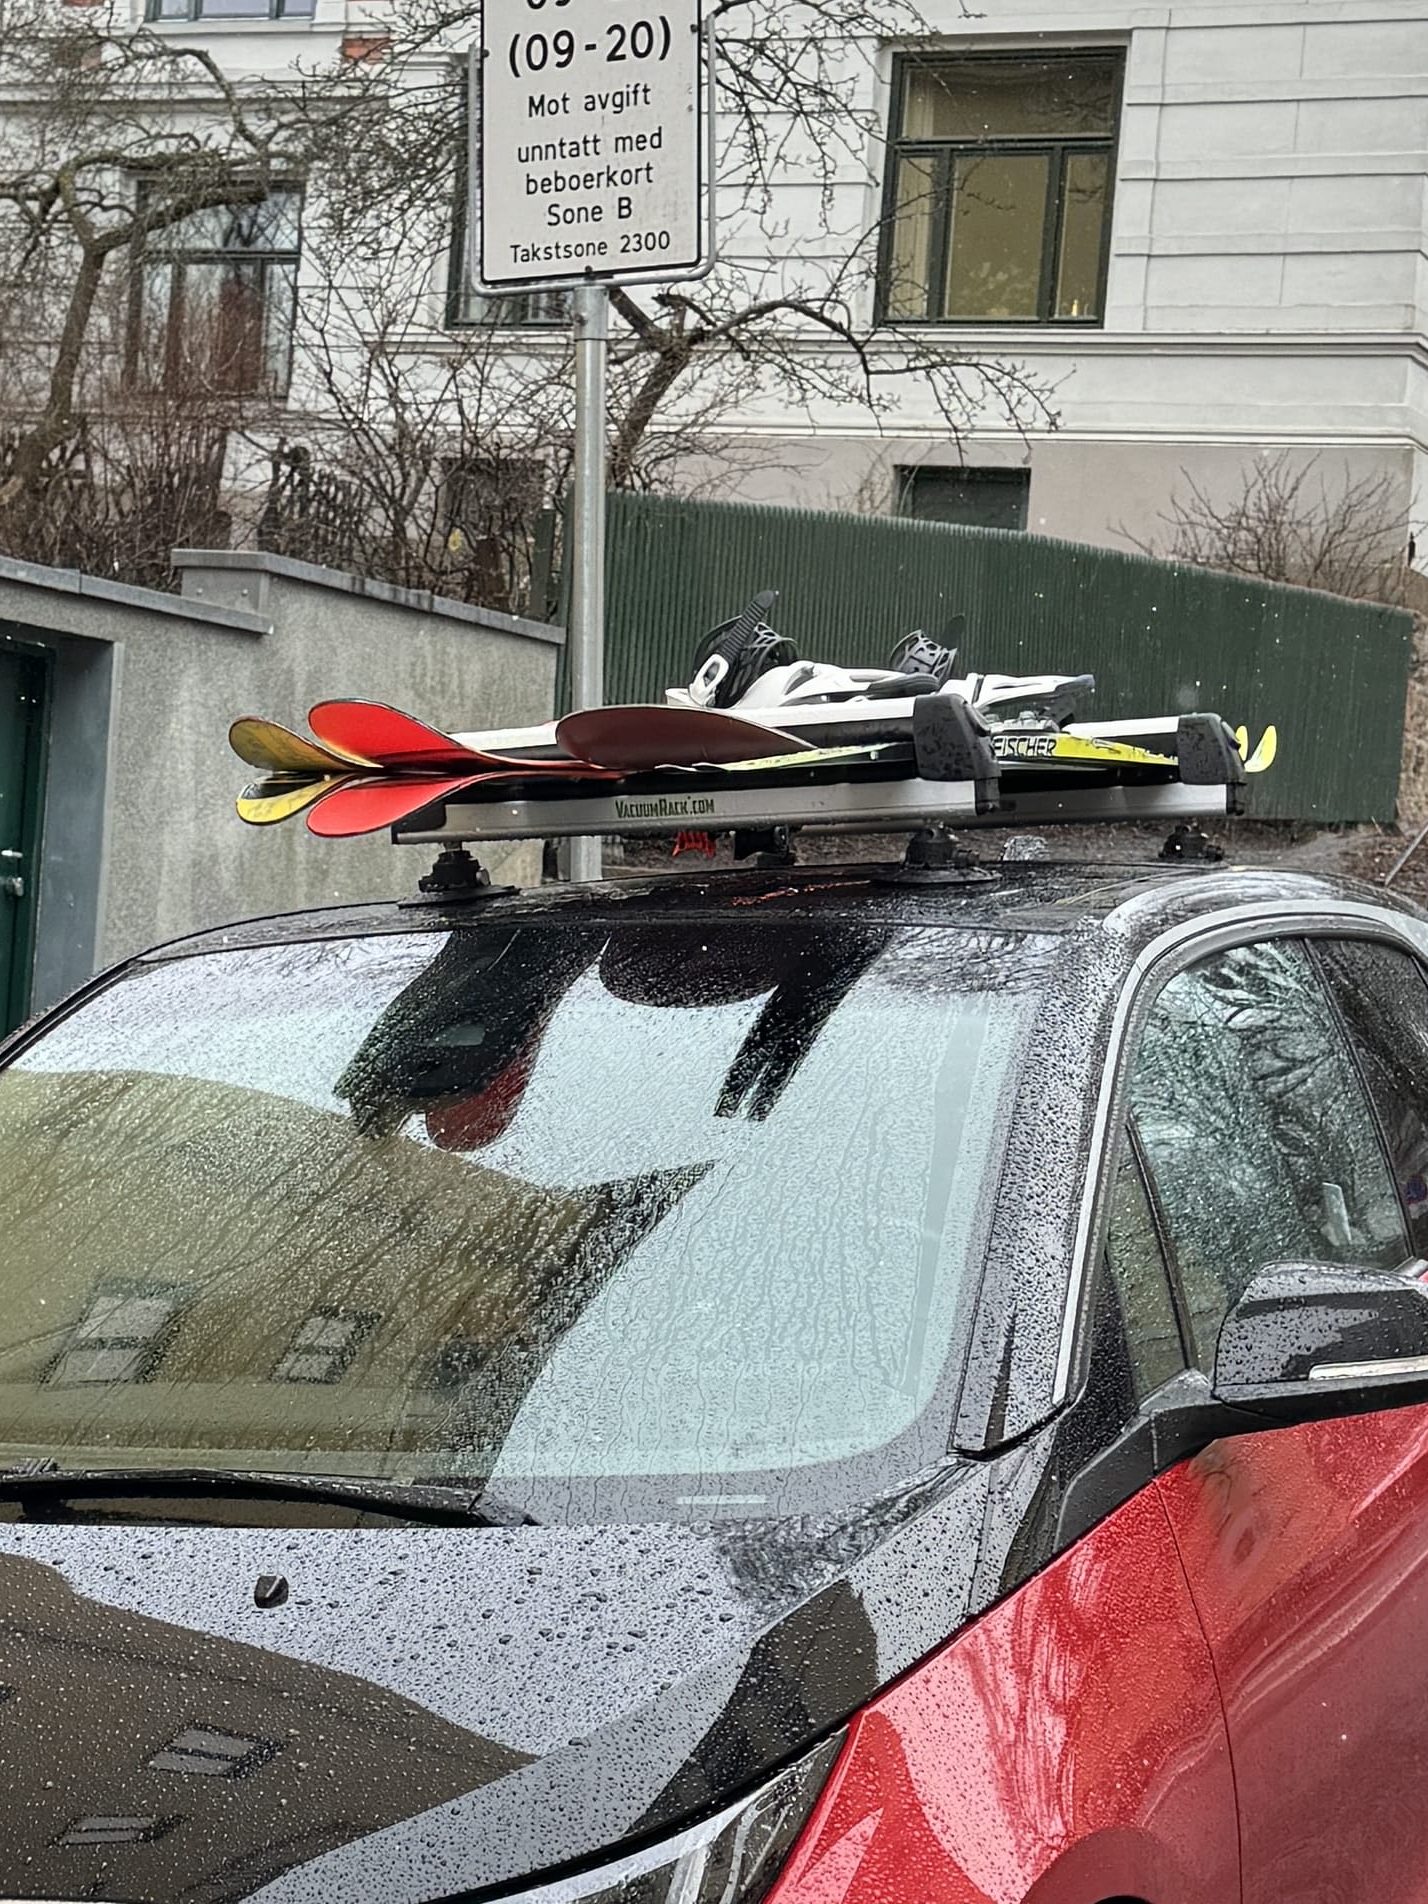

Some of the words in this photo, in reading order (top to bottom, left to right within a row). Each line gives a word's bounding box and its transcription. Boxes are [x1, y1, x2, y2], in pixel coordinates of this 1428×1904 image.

[528, 92, 570, 118] Mot
[584, 82, 651, 114] avgift
[517, 133, 601, 163] unntatt
[614, 125, 662, 154] med
[526, 162, 654, 195] beboerkort
[547, 203, 604, 227] Sone
[617, 196, 633, 219] B
[510, 240, 608, 263] Takstsone
[619, 230, 671, 254] 2300
